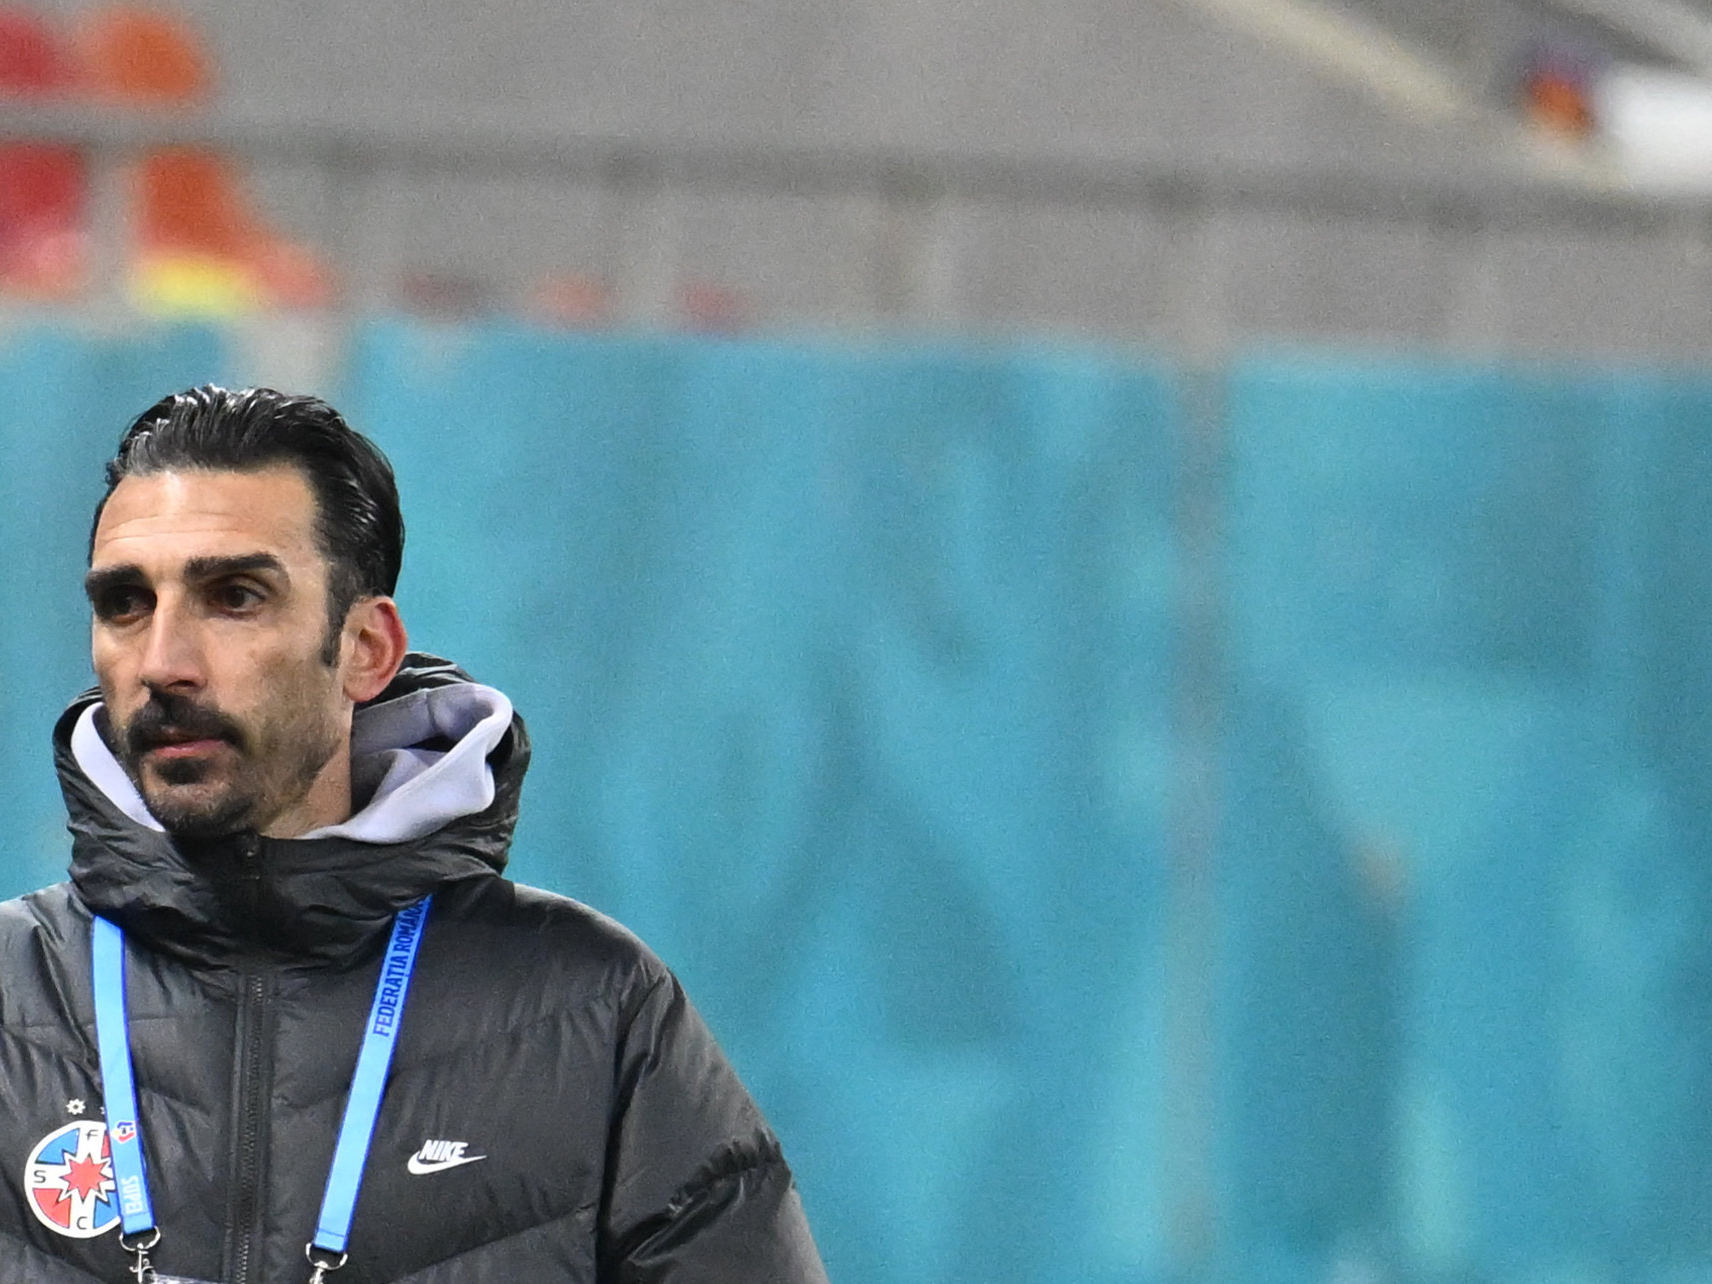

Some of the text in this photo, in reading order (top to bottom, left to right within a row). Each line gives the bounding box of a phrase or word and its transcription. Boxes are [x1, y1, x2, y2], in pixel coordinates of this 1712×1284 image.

[418, 1139, 469, 1162] NIKE
[33, 1170, 46, 1183] S
[76, 1216, 88, 1230] C
